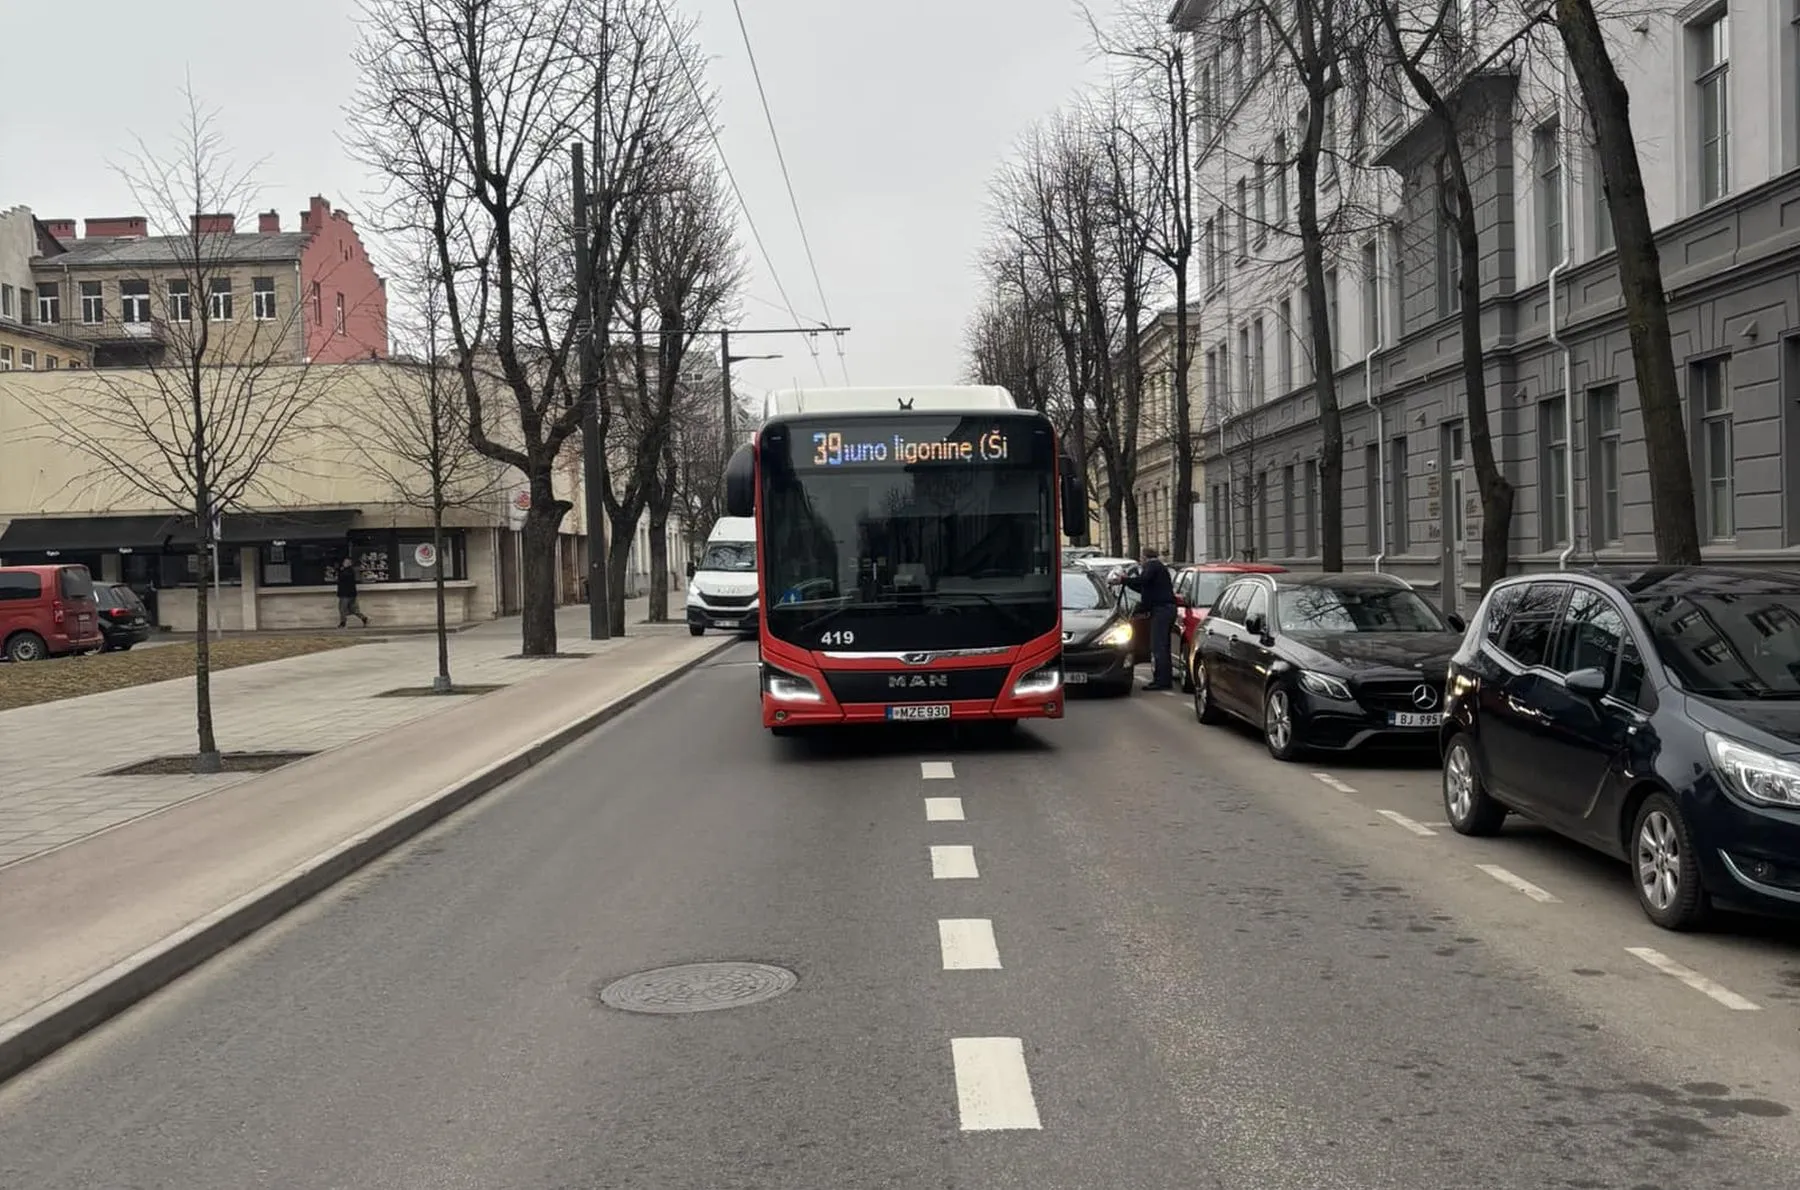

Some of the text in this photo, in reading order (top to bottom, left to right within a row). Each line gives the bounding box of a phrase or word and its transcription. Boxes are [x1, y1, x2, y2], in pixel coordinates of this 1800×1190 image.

[812, 432, 842, 465] 39
[821, 630, 855, 645] 419
[888, 674, 948, 688] MAN
